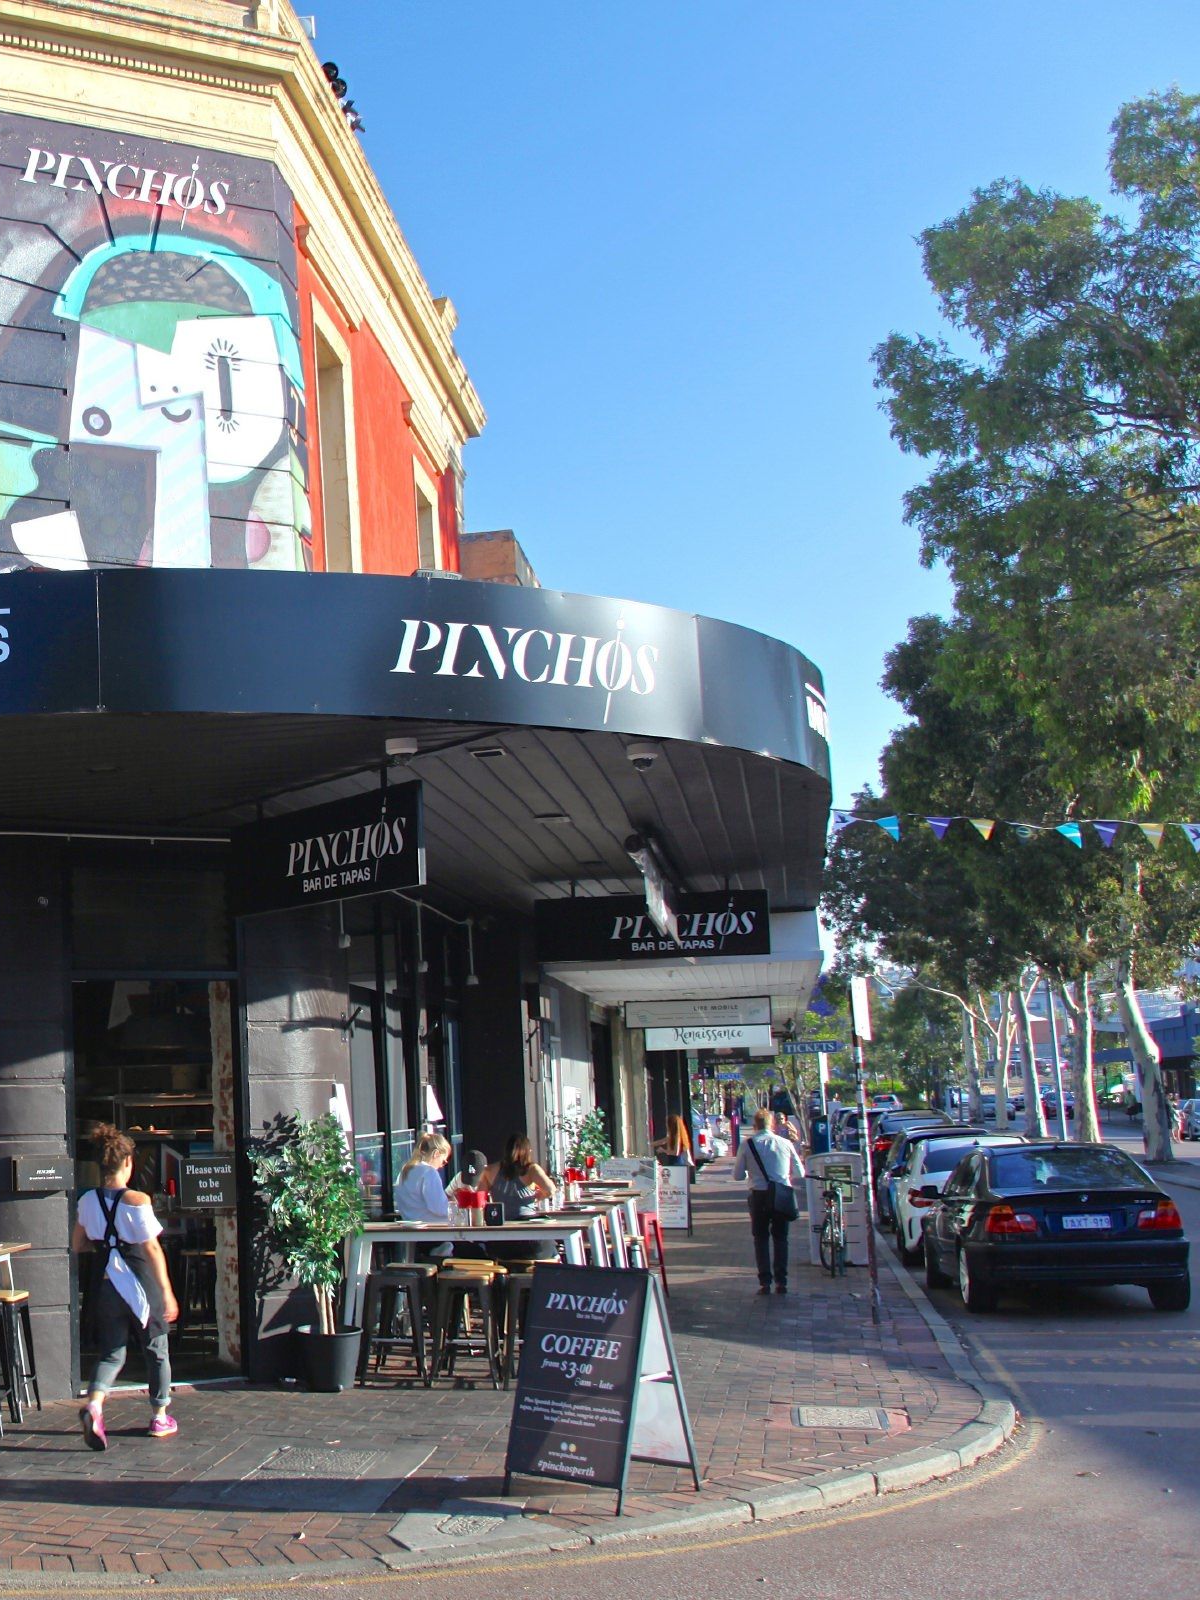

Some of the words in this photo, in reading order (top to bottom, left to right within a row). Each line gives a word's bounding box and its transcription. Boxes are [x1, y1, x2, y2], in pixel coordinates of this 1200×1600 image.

[19, 147, 231, 217] PINCHOS
[389, 618, 659, 696] PINCHOS
[286, 816, 407, 877] PINCHOS
[303, 877, 322, 893] BAR
[324, 874, 338, 889] DE
[340, 867, 371, 885] TAPAS
[609, 910, 757, 940] PICHOS
[632, 941, 655, 951] BAR
[659, 941, 675, 950] DE
[679, 939, 715, 949] TAPAS
[673, 1027, 744, 1045] Renaissance
[786, 1042, 835, 1053] TICKETS
[186, 1164, 213, 1175] Please
[214, 1164, 232, 1175] wait
[199, 1179, 207, 1188] to
[209, 1178, 219, 1188] be
[196, 1192, 223, 1202] seated
[545, 1292, 628, 1315] PINCHOS
[540, 1333, 622, 1361] COFFEE
[541, 1358, 560, 1369] from
[599, 1379, 614, 1390] late
[537, 1459, 595, 1477] #pinchosperth
